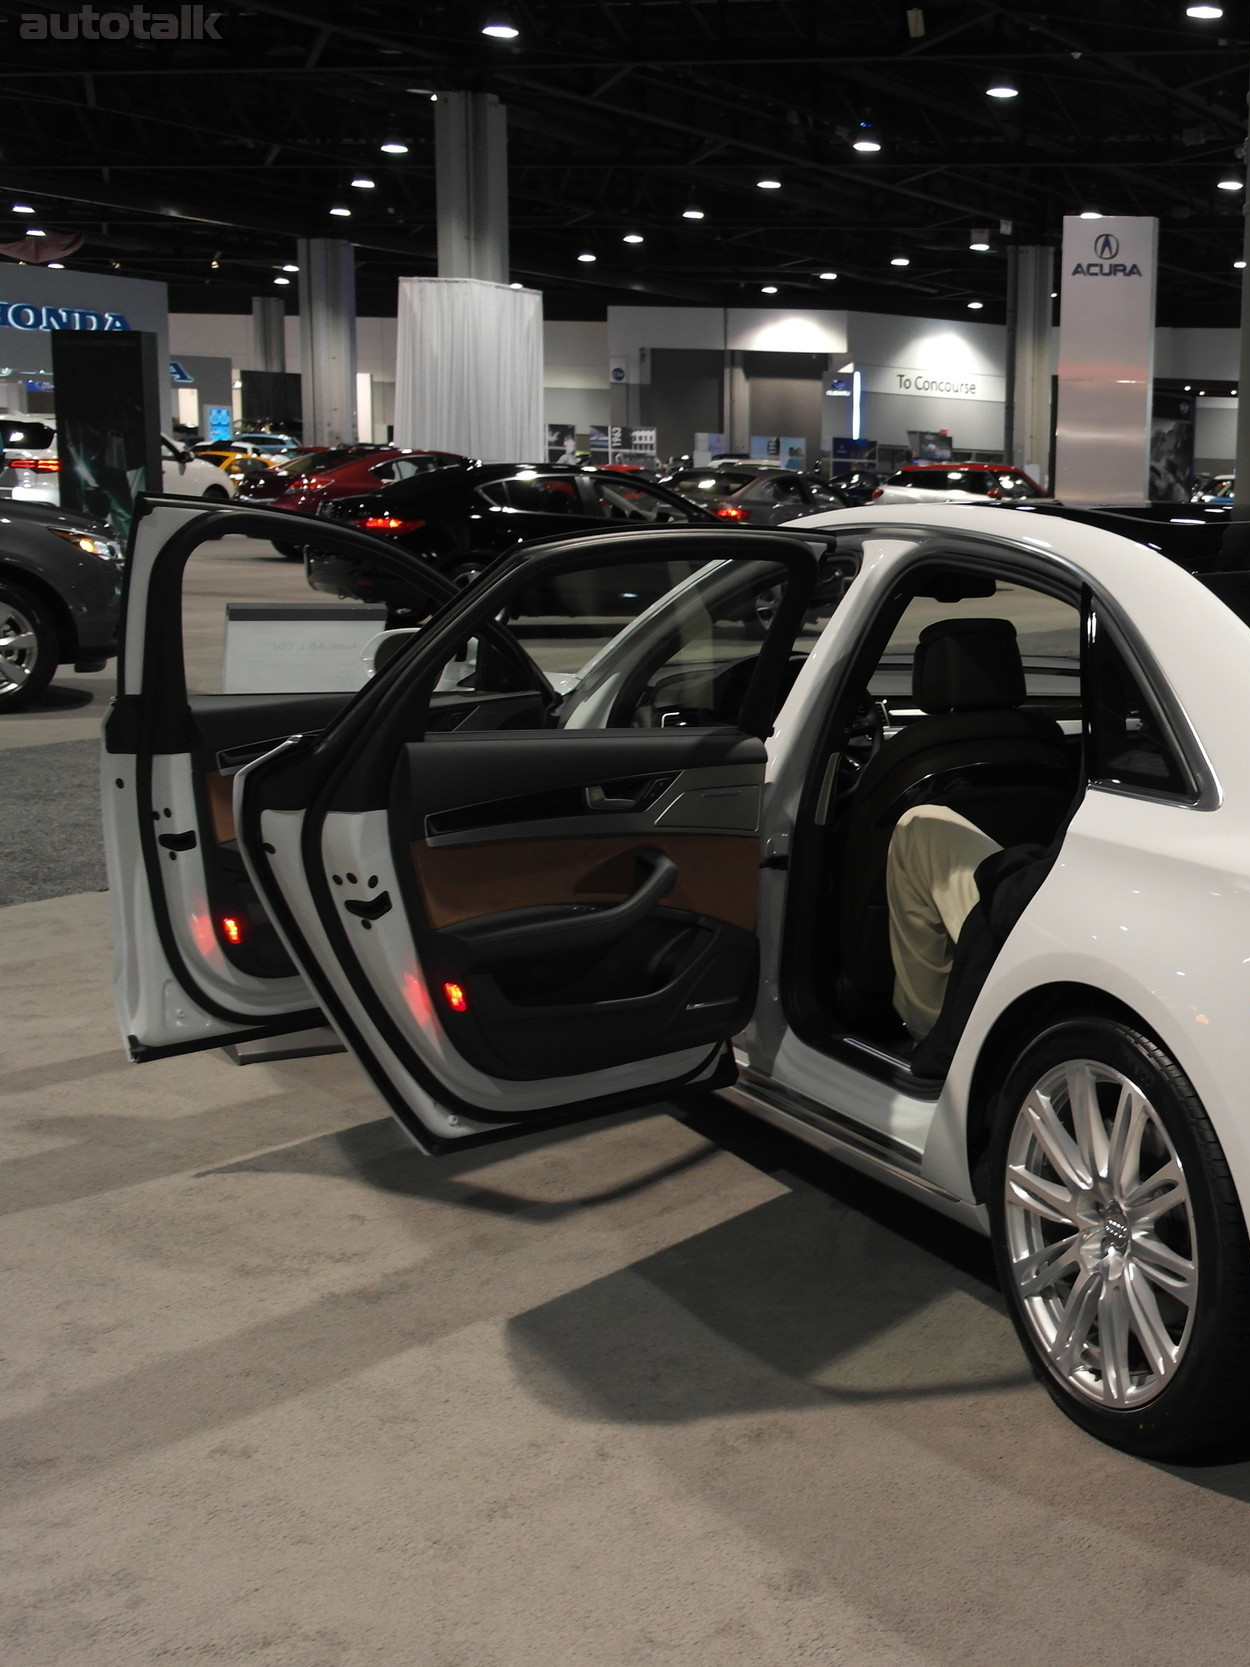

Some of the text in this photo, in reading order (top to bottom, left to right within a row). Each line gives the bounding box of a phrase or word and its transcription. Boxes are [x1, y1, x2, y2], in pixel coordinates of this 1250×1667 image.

[1071, 262, 1142, 277] ACURA
[896, 374, 977, 395] To Concourse
[611, 426, 622, 448] 1963
